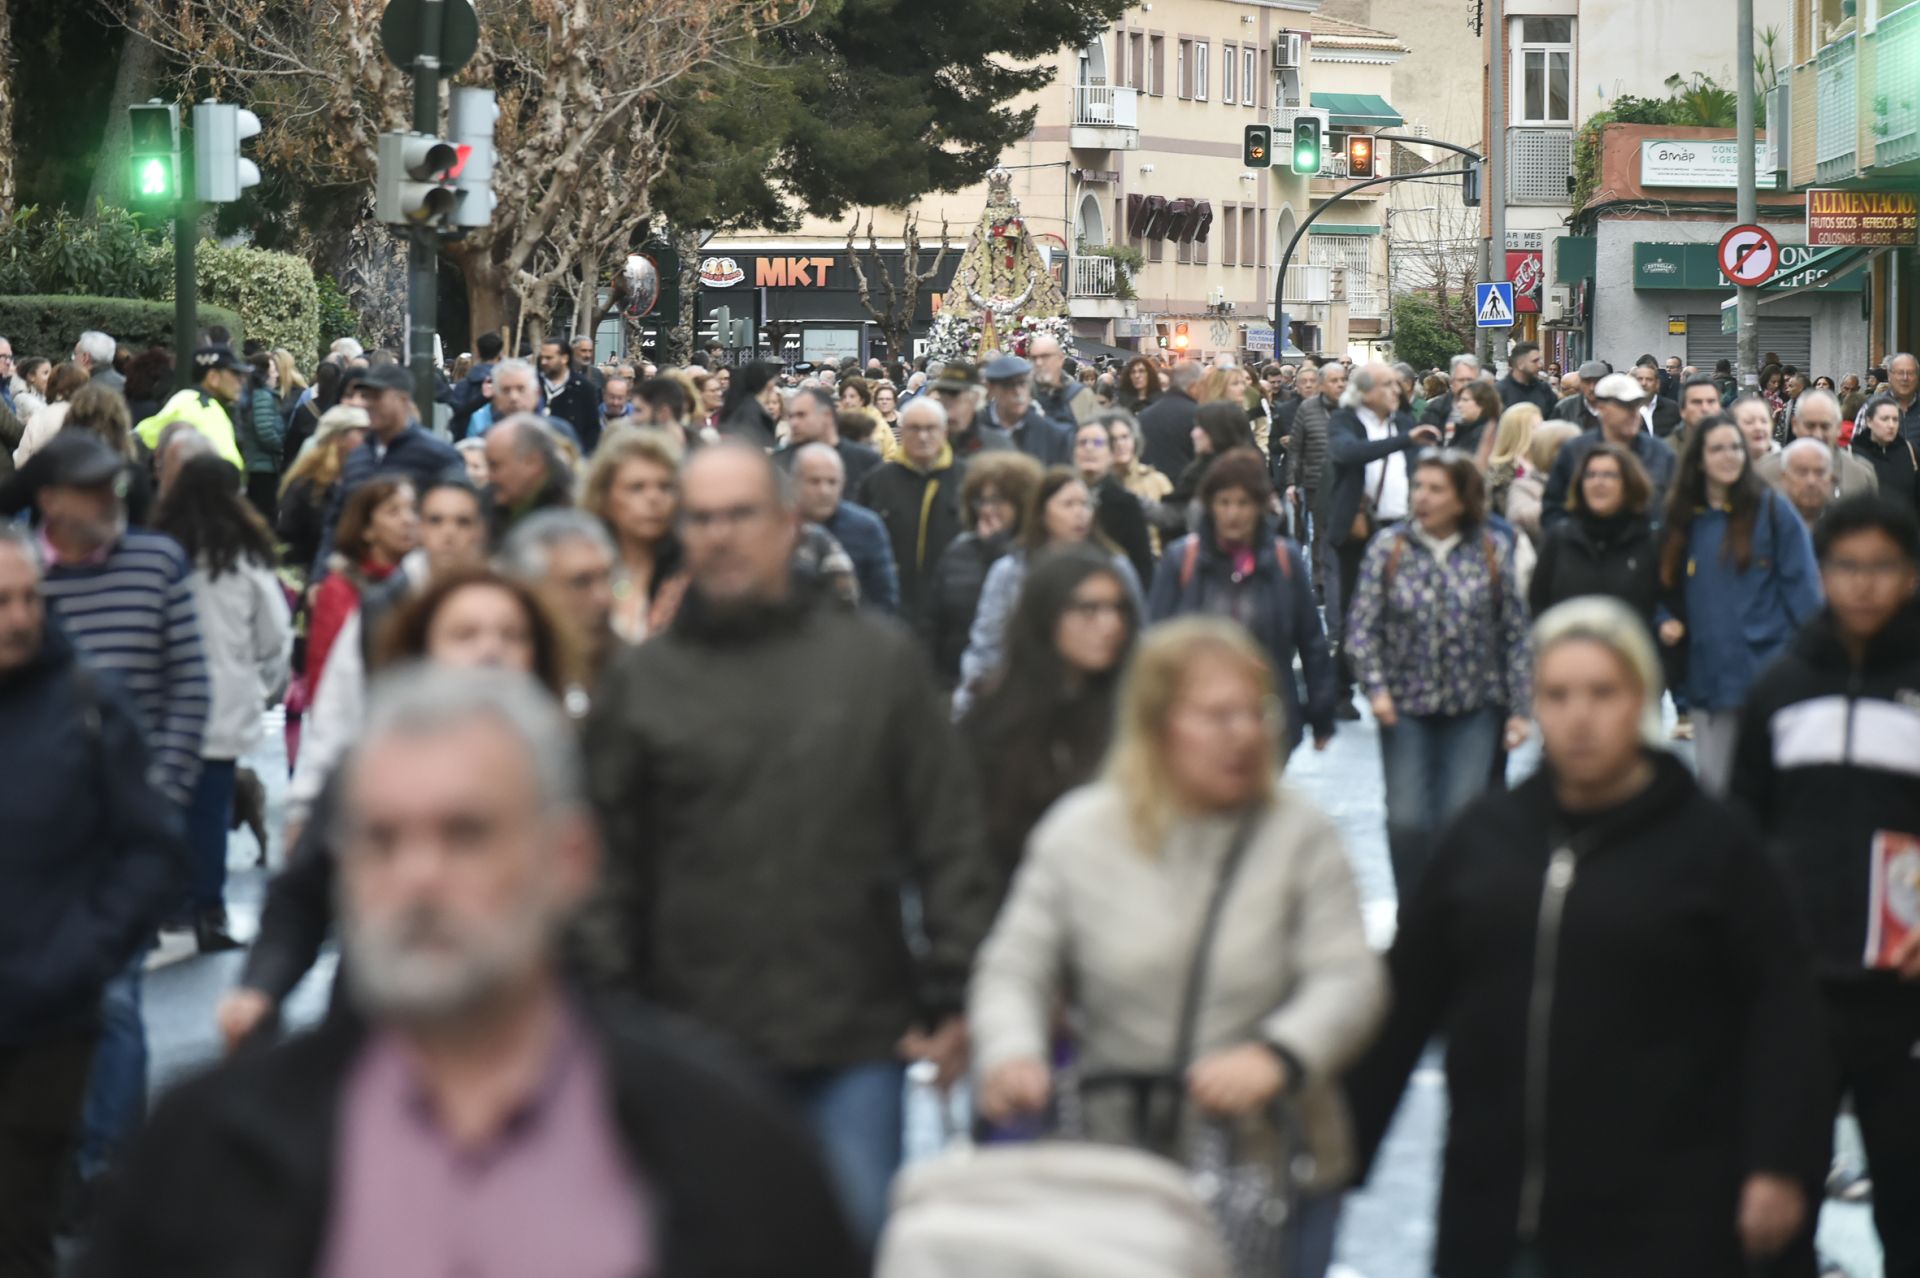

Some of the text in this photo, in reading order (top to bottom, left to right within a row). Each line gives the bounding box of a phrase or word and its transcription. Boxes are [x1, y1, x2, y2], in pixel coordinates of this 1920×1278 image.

[1810, 216, 1835, 229] FRUTOS
[1836, 216, 1857, 229] SECOS
[1862, 216, 1897, 229] REFRESCOS
[1524, 232, 1542, 240] MES
[1818, 232, 1856, 244] GOLOSINAS
[756, 257, 834, 287] MKT
